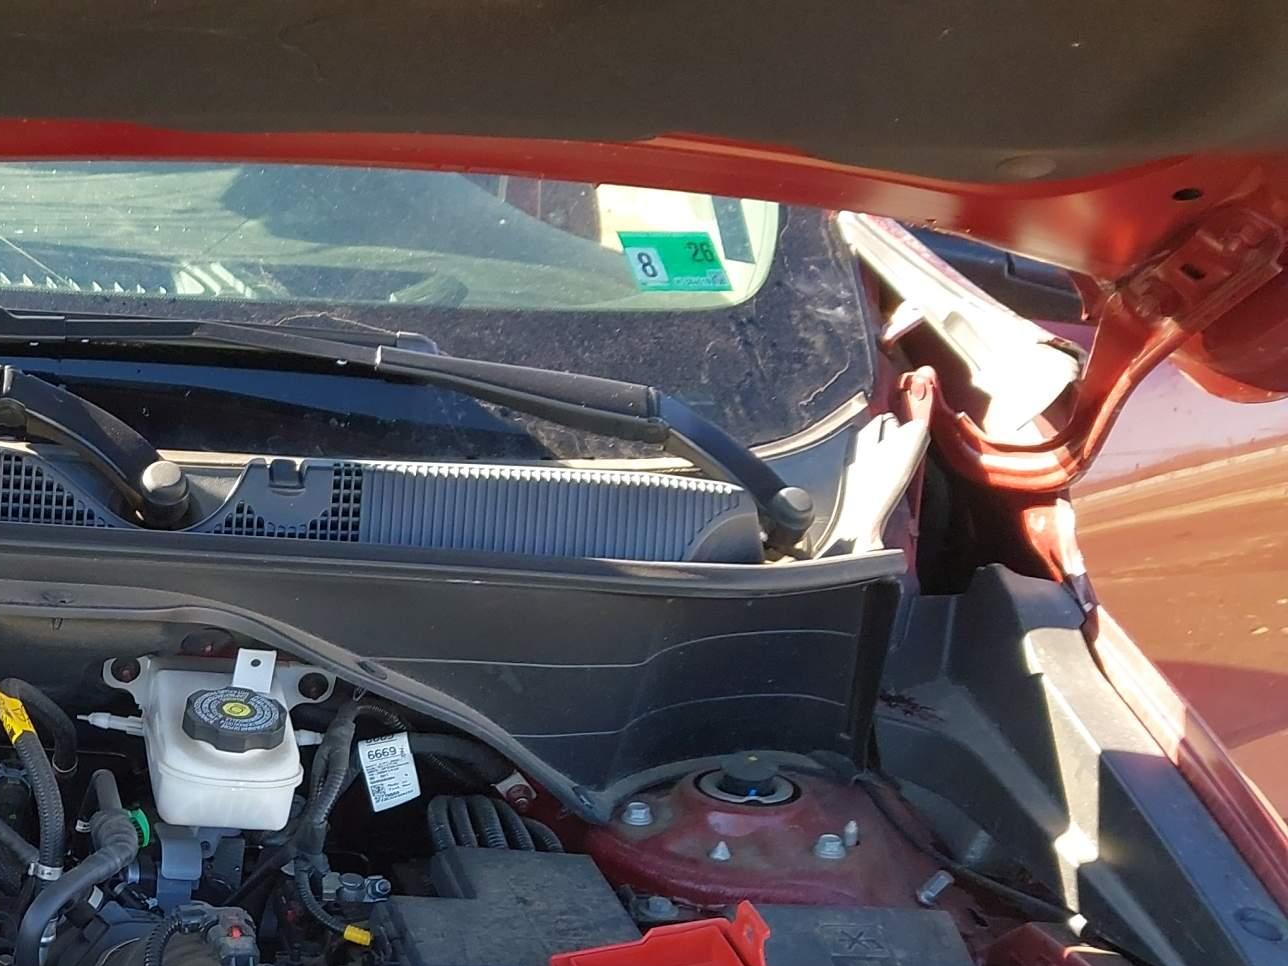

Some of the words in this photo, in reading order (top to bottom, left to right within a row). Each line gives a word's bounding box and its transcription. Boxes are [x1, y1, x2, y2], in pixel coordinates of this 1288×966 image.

[686, 241, 715, 263] 26
[637, 252, 658, 278] 8
[367, 746, 398, 760] 6669
